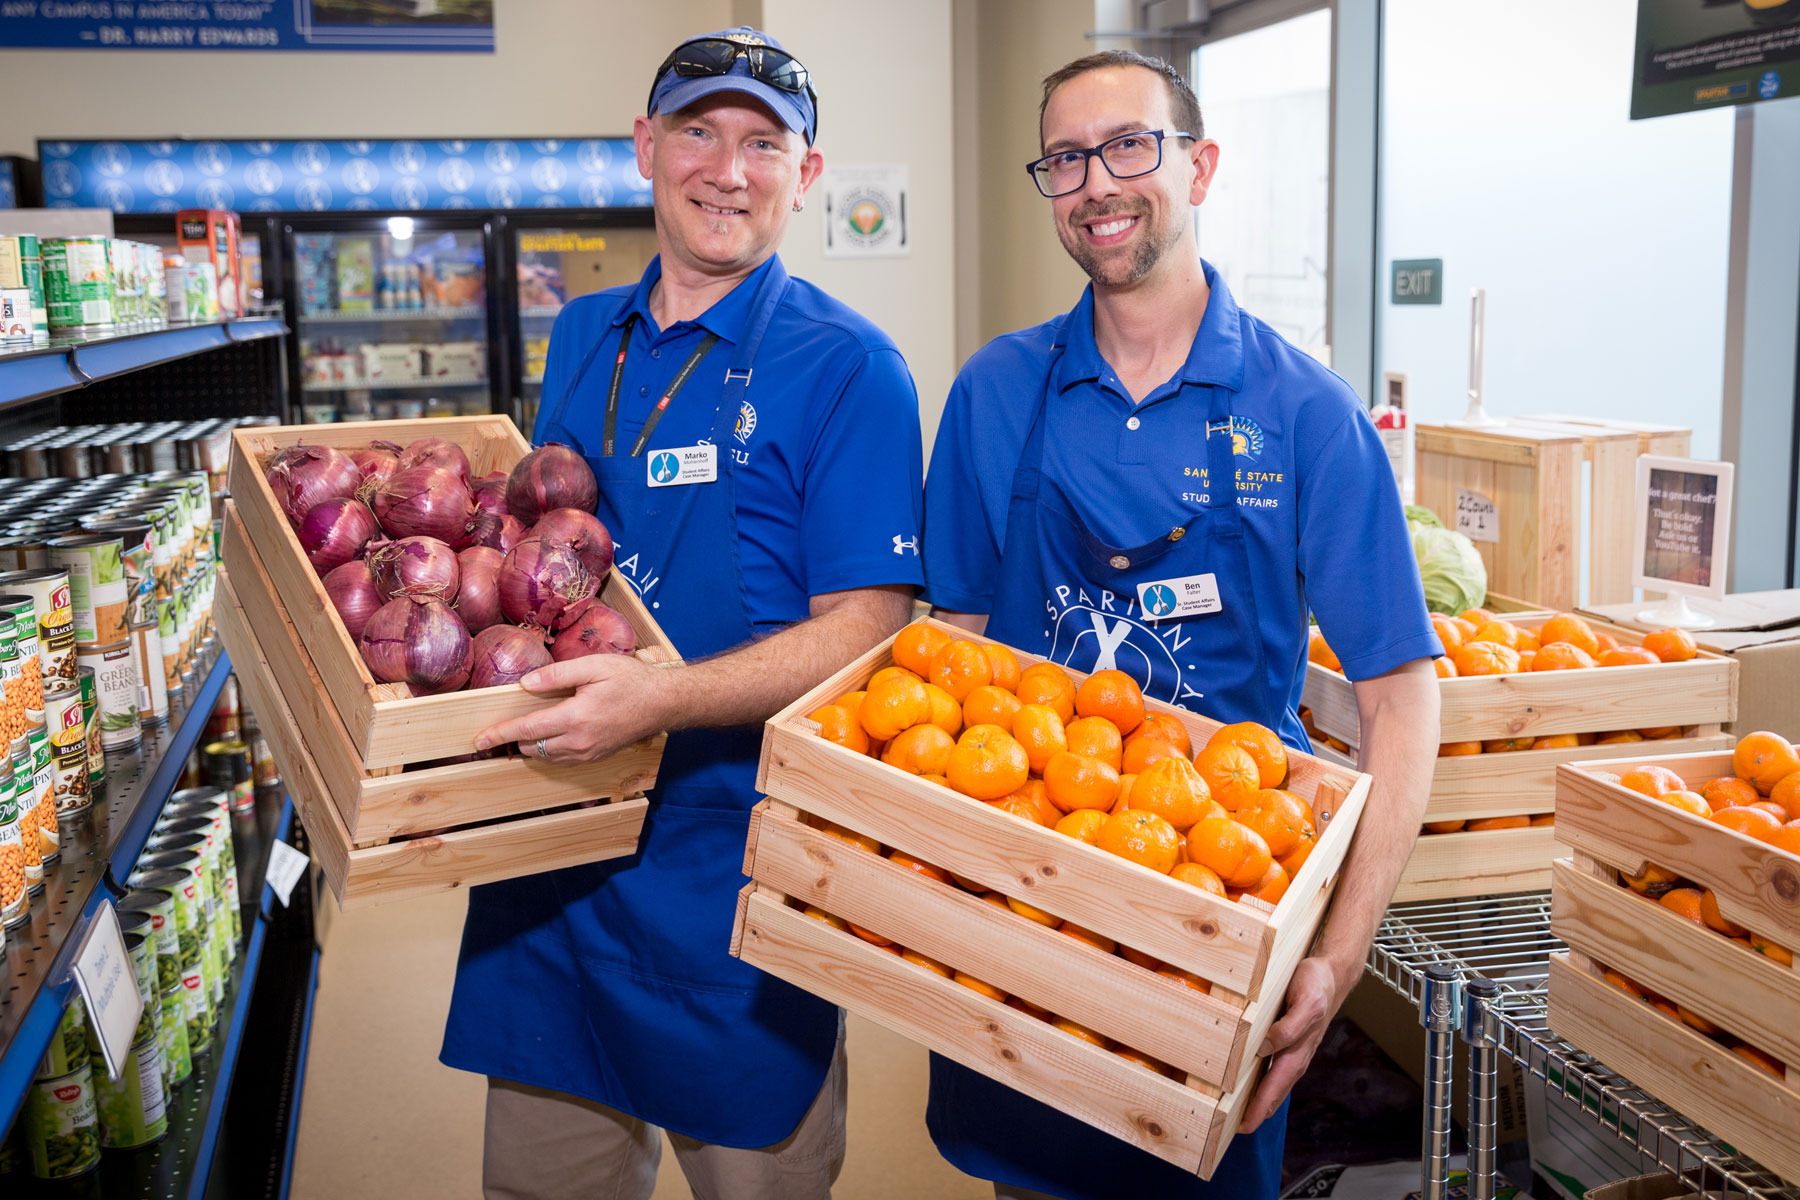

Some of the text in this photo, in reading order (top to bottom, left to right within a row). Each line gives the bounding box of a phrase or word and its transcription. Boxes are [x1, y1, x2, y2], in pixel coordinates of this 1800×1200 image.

[40, 2, 112, 19] CAMPUS
[114, 3, 134, 19] IN
[136, 3, 210, 20] AMERICA
[99, 25, 131, 45] DR.
[134, 26, 195, 46] HARRY
[198, 27, 279, 46] EDWARDS
[1396, 269, 1433, 296] EXIT
[685, 452, 708, 460] Marko
[1184, 467, 1209, 478] SAN
[1247, 471, 1284, 483] STATE
[1236, 496, 1279, 508] AFFAIRS
[50, 626, 69, 637] BLACK
[100, 666, 134, 683] GREEN
[104, 678, 136, 693] BEANS
[60, 744, 81, 755] BLACK
[65, 1103, 84, 1118] Cut
